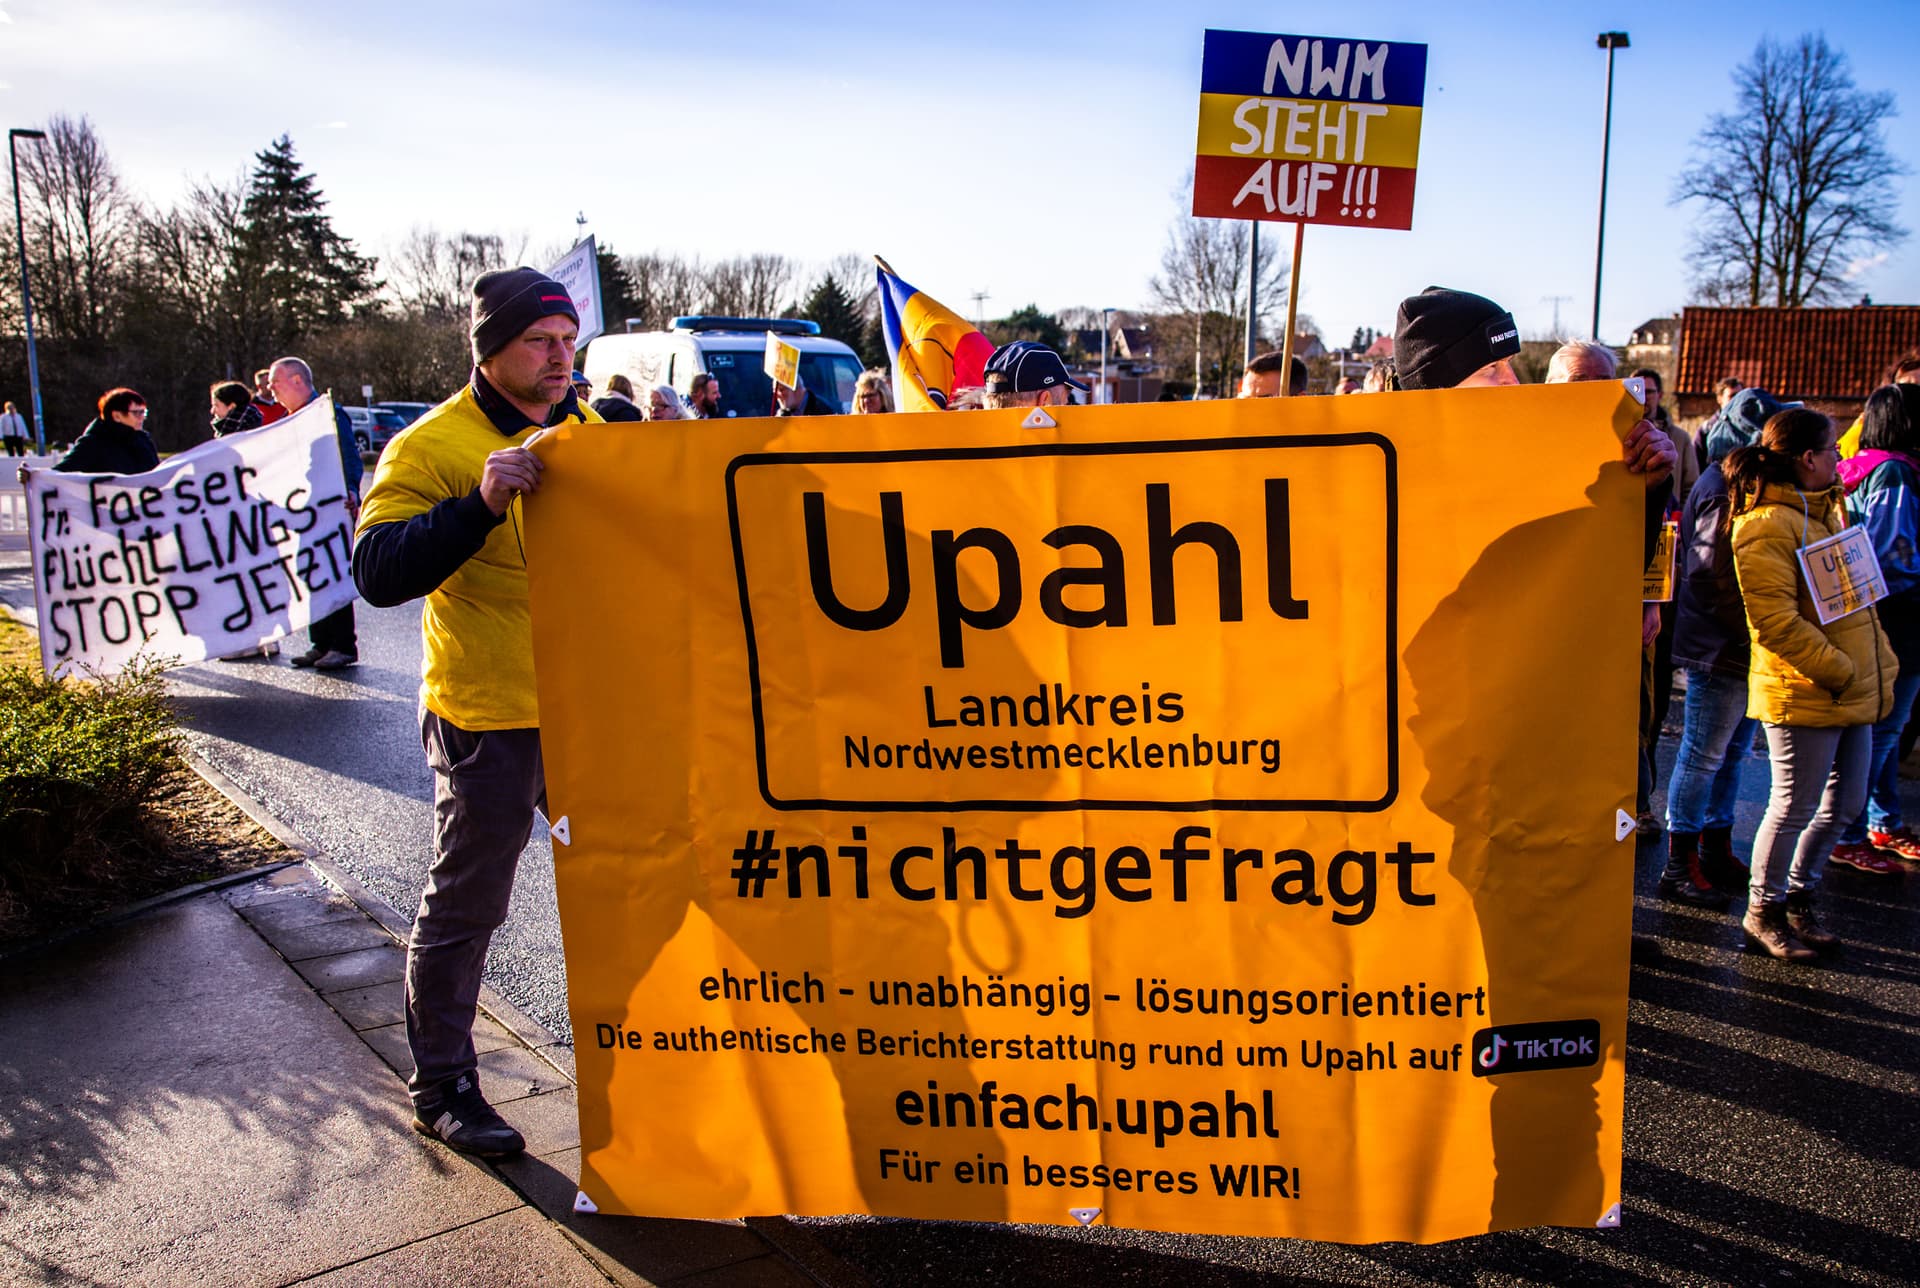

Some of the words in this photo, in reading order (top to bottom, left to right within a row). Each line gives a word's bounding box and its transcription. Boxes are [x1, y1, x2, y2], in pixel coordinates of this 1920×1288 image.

[1263, 38, 1389, 100] NWM
[1230, 97, 1389, 163] STEHT
[1231, 159, 1379, 219] AUF!!!
[89, 466, 257, 529] Faeser
[803, 478, 1309, 669] Upahl
[49, 584, 199, 657] STOPP
[924, 682, 1184, 728] Landkreis
[844, 733, 1280, 774] Nordwestmecklenburg
[730, 826, 1436, 925] #nichtgefragt
[700, 968, 825, 1004] ehrlich
[869, 975, 1091, 1017] unabhängig
[1136, 978, 1487, 1024] lösungsorientiert
[595, 1023, 642, 1050] Die
[653, 1026, 846, 1054] authentische
[857, 1028, 1137, 1071] Berichterstattung
[1149, 1039, 1223, 1067] rund
[1237, 1046, 1288, 1067] um
[1301, 1039, 1397, 1077] Upahl
[1409, 1042, 1463, 1072] auf
[1513, 1035, 1595, 1060] TikTok
[895, 1080, 1279, 1148] einfach.upahl
[879, 1148, 941, 1184] Für
[954, 1153, 1009, 1185] ein
[1023, 1155, 1198, 1195] besseres
[1209, 1164, 1300, 1200] WIR!
